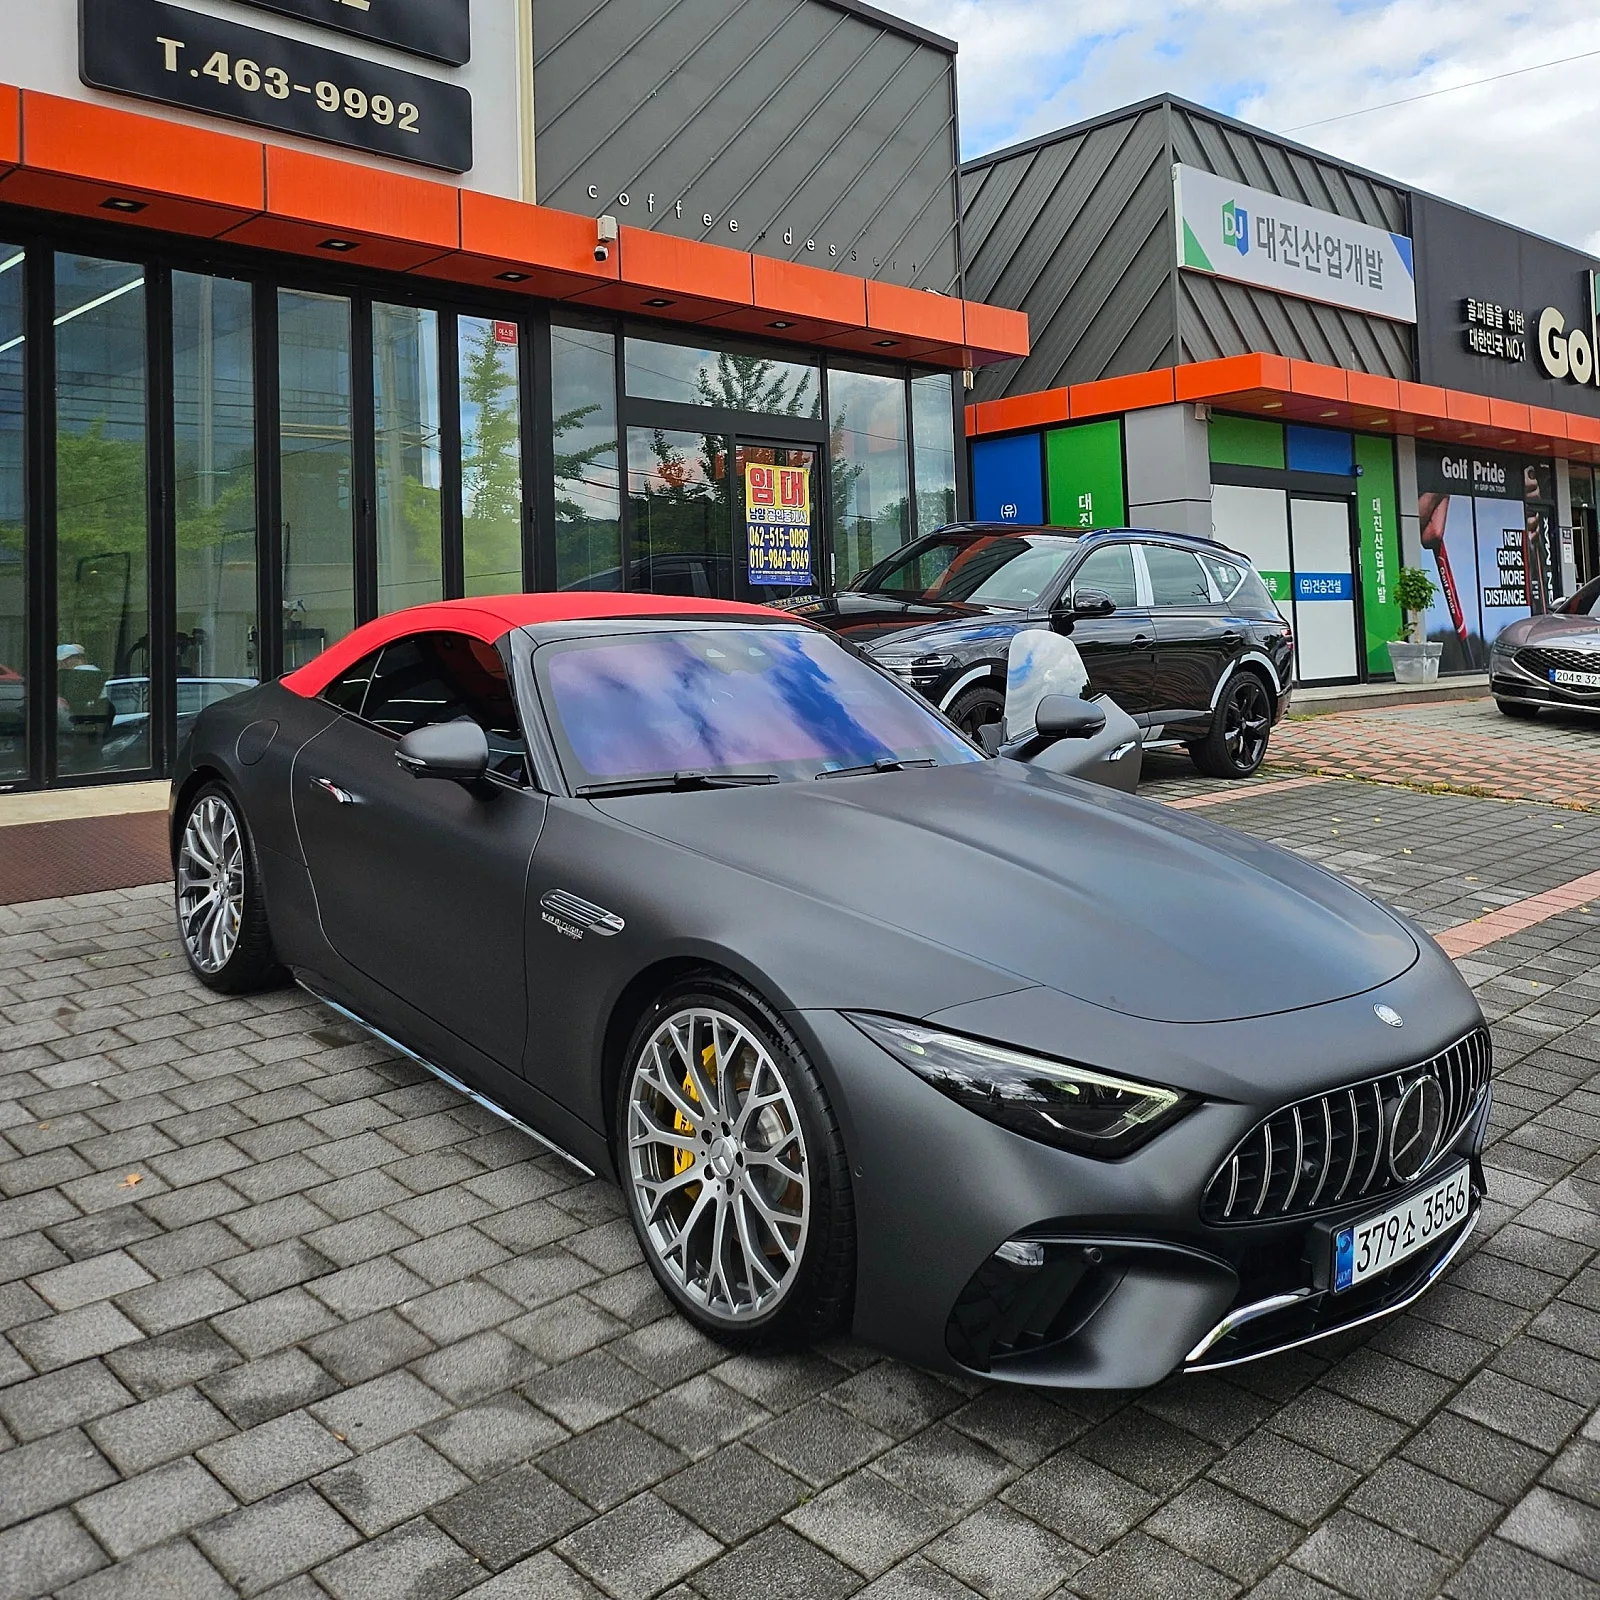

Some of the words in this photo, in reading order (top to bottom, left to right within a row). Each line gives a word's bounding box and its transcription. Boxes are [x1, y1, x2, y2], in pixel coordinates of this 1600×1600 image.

[156, 37, 420, 134] T.463-9992
[587, 184, 739, 232] coffee
[1224, 211, 1244, 240] DJ
[1256, 216, 1383, 290] 대진산업개발
[1467, 298, 1504, 329] 골퍼들을
[1508, 309, 1525, 335] 위한
[1469, 328, 1504, 358] 대한민국
[1505, 337, 1527, 362] NO.1
[1441, 456, 1468, 480] Golf
[1473, 460, 1505, 484] Pride
[749, 525, 809, 549] 062-515-0089
[1372, 498, 1387, 604] 대진산업개발
[1504, 531, 1523, 547] NEW
[1497, 550, 1524, 566] GRIPS.
[1300, 579, 1342, 594] (유)건승건설
[1500, 570, 1525, 585] MORE
[1485, 589, 1527, 606] DISTANCE.
[1585, 674, 1600, 685] 32
[1356, 1210, 1416, 1273] 379소
[1421, 1175, 1466, 1237] 3556
